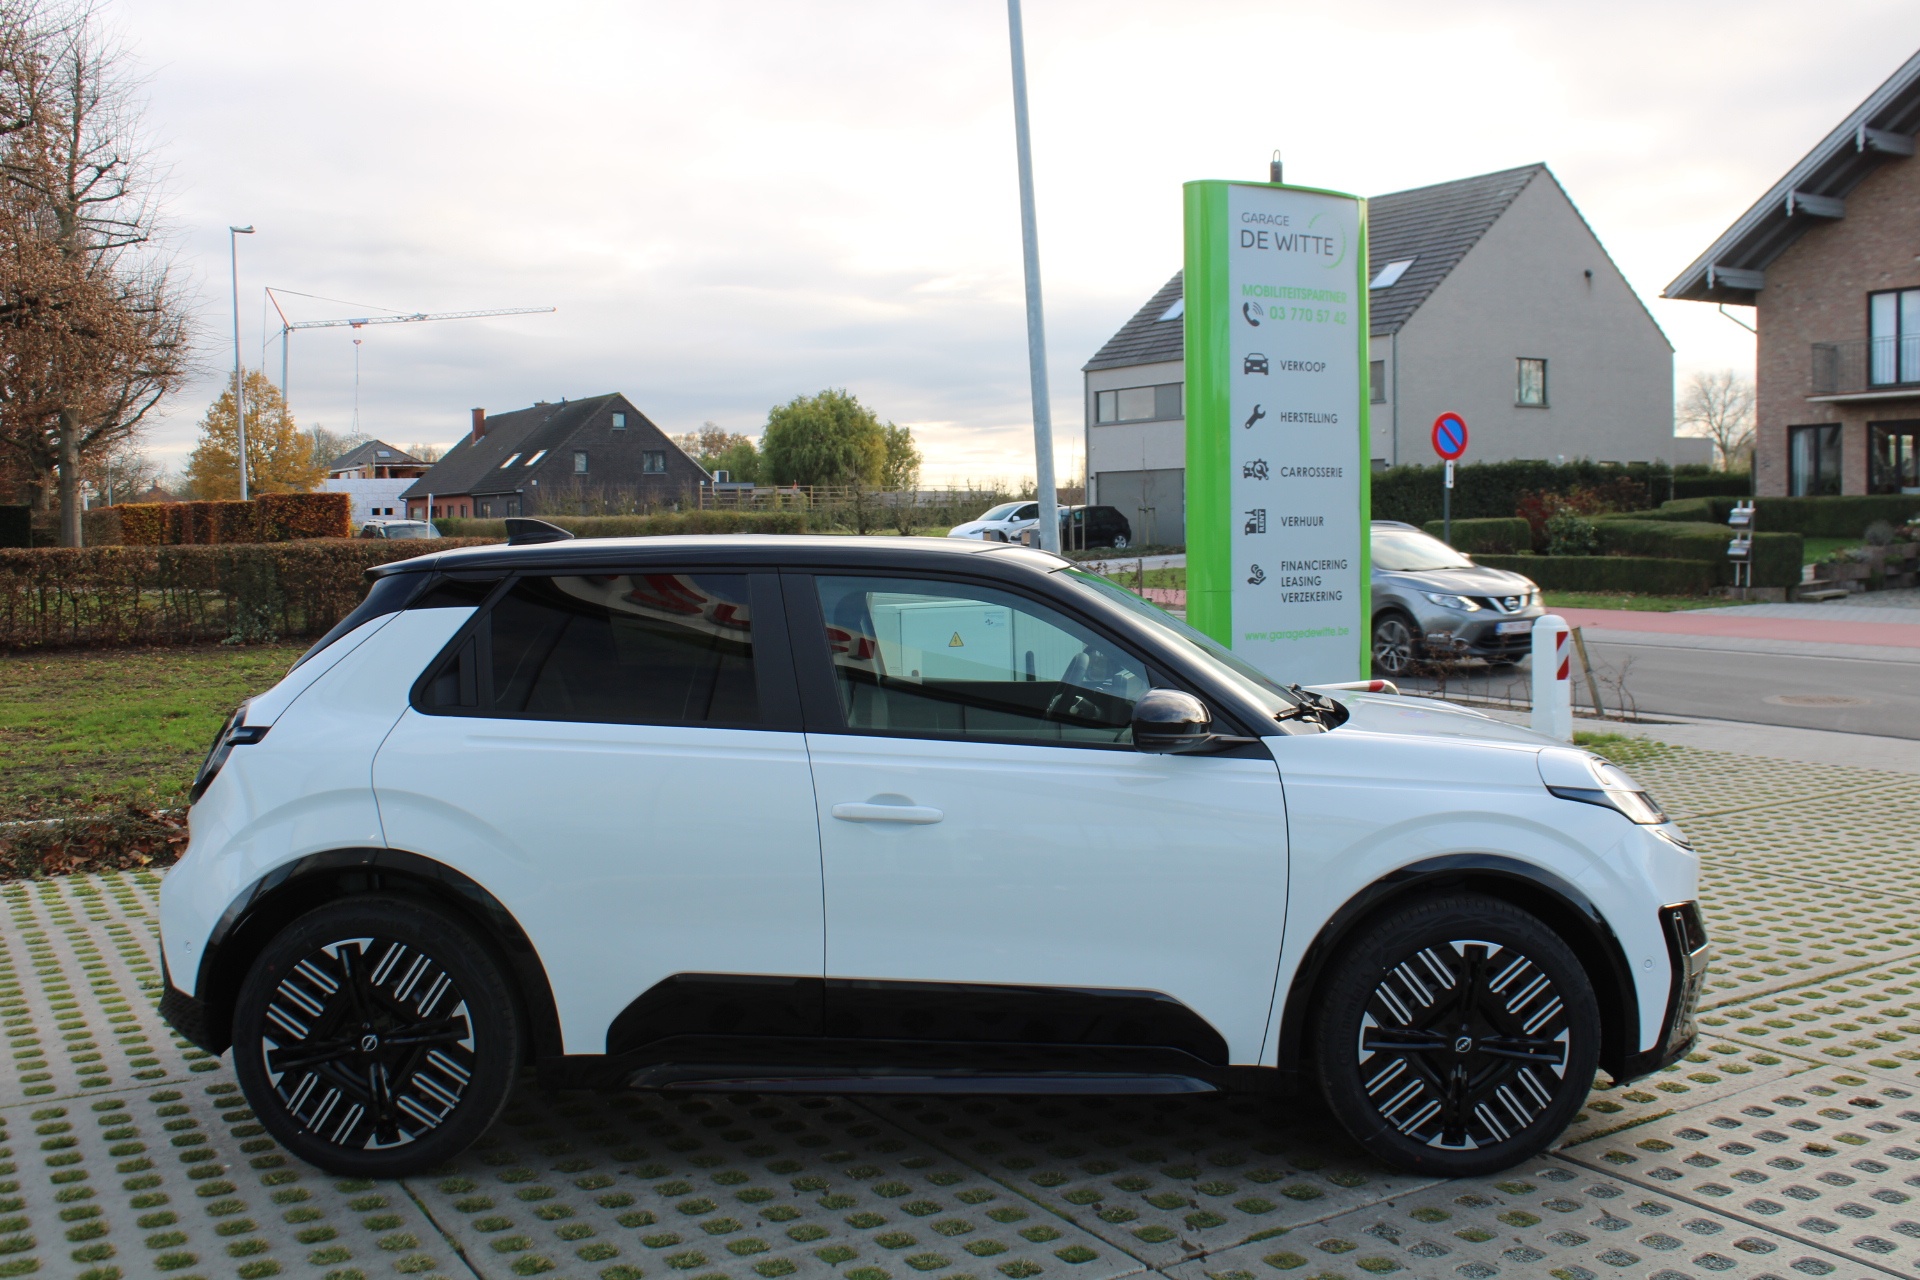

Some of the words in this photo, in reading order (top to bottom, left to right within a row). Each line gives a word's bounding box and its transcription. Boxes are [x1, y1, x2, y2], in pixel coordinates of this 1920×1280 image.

[1242, 212, 1289, 226] GARAGE
[1241, 230, 1268, 249] DE
[1275, 232, 1333, 256] WITTE
[1242, 284, 1347, 303] MOBILITEITSPARTNER
[1270, 306, 1286, 320] 03
[1291, 307, 1313, 322] 770
[1316, 310, 1330, 322] 57
[1334, 312, 1347, 325] 42
[1280, 360, 1326, 373] VERKOOP
[1281, 412, 1337, 423] HERSTELLING
[1281, 466, 1343, 478] CARROSSERIE
[1281, 516, 1324, 527] VERHUUR
[1281, 560, 1347, 571] FINANCIERING
[1281, 576, 1321, 587] LEASING
[1281, 591, 1342, 602] VERZEKERING
[1245, 626, 1349, 642] www.garagedewitte.be
